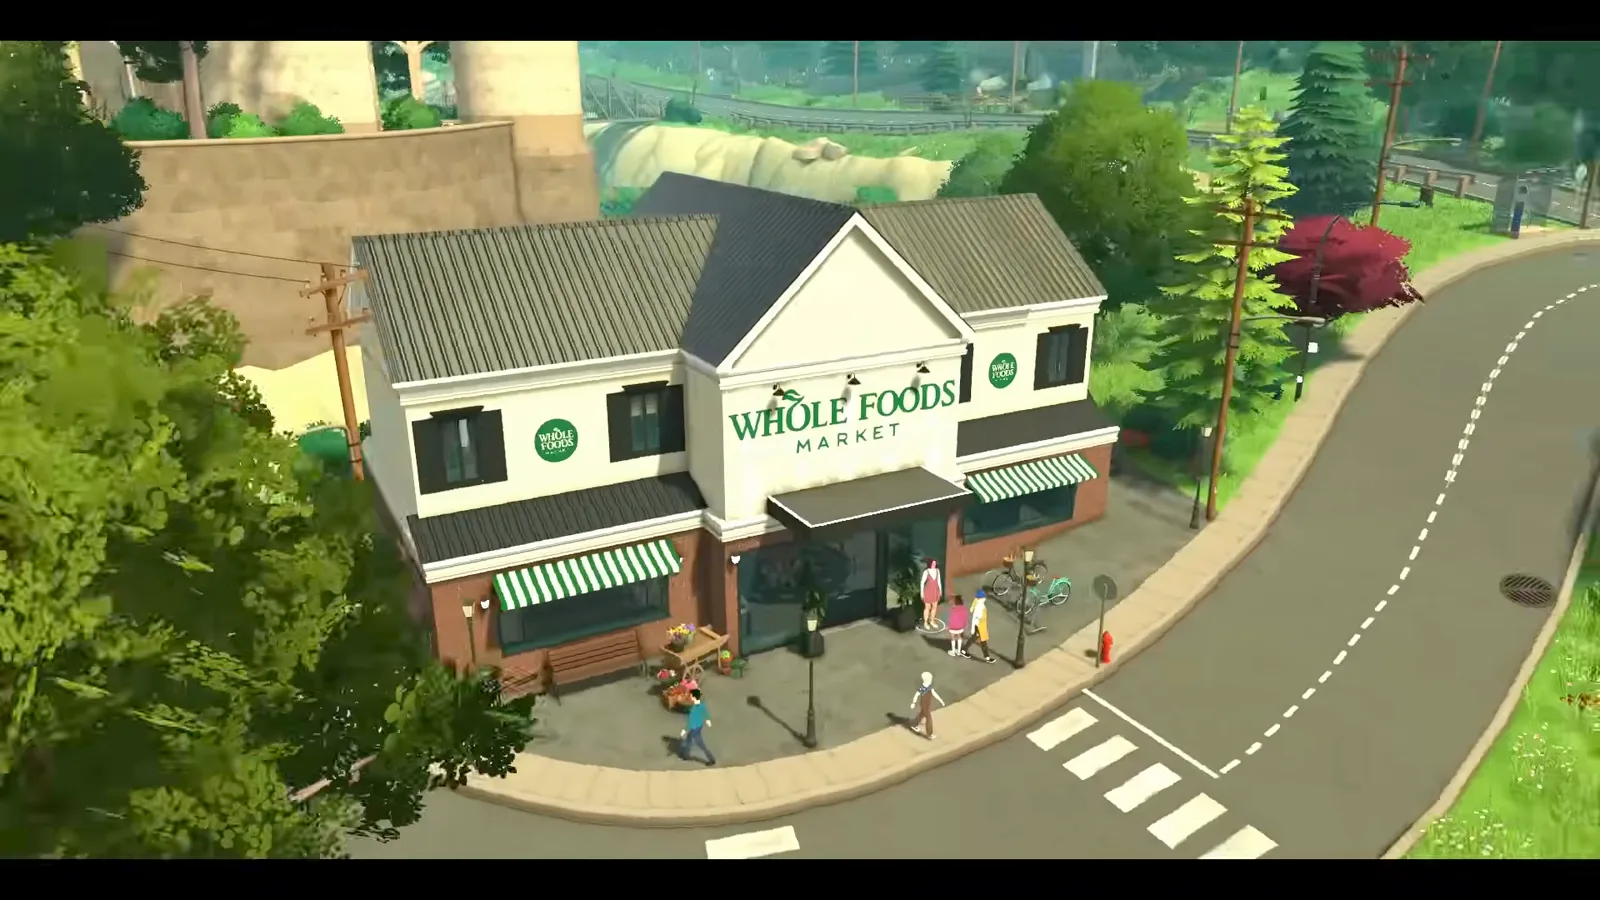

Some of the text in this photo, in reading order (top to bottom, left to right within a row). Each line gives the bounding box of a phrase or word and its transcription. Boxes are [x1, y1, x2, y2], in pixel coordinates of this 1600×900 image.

[728, 379, 956, 441] WHOLE FOODS
[538, 429, 574, 442] WHOLE
[541, 438, 574, 451] FOODS
[796, 423, 900, 454] MARKET
